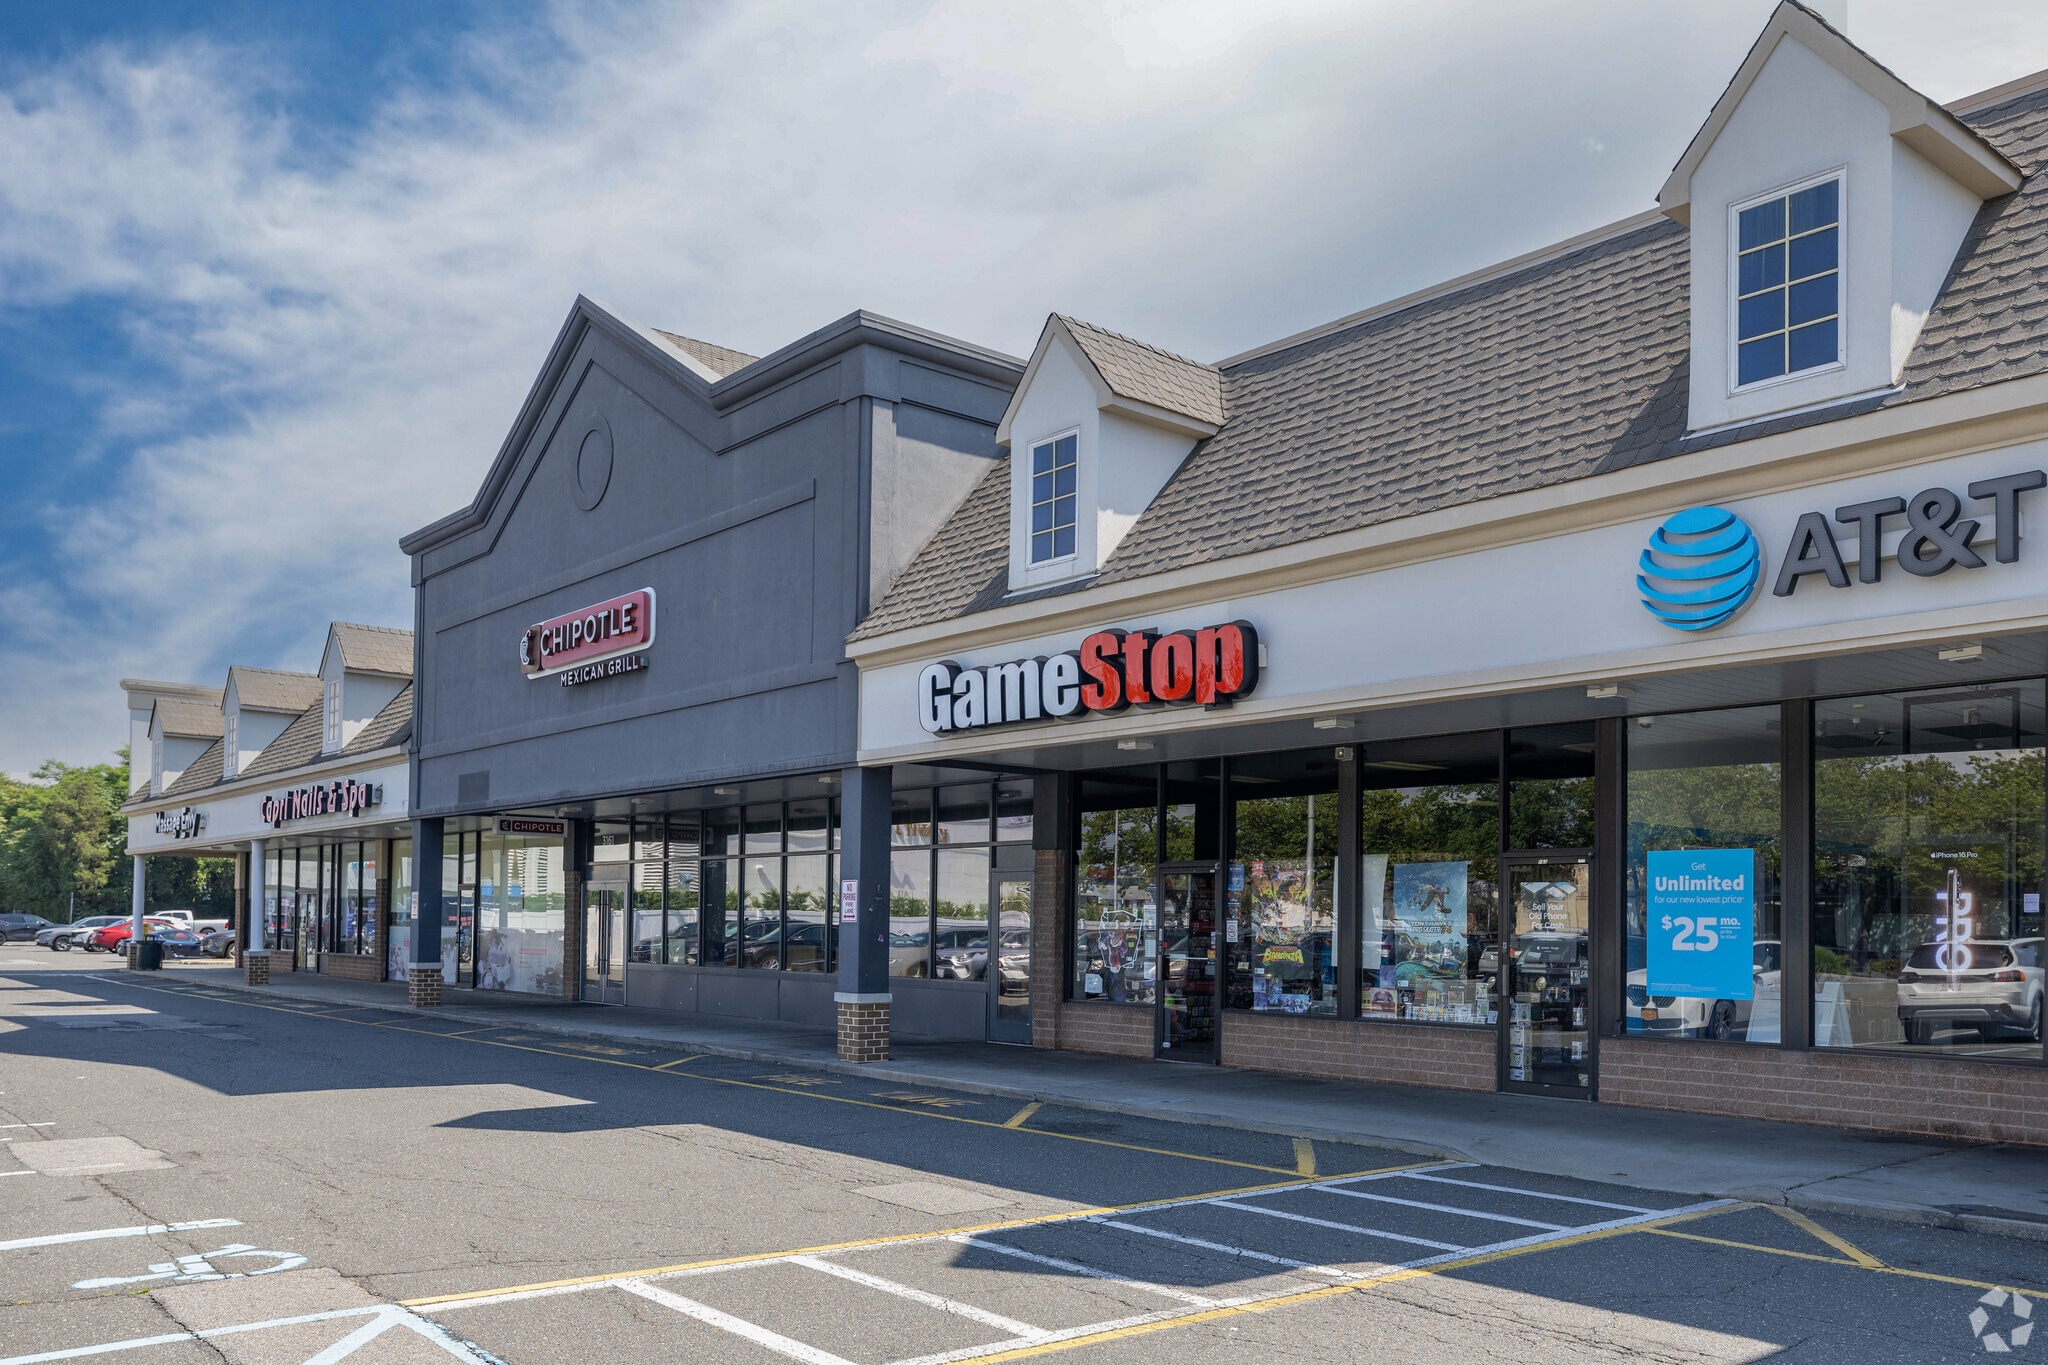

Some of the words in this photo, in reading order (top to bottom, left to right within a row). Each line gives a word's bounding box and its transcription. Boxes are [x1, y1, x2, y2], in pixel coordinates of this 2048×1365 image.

[1773, 469, 2047, 597] AT&T
[540, 602, 637, 657] CHIPOTLE
[560, 664, 604, 688] MEXICAN
[608, 655, 640, 676] GRILL
[918, 620, 1257, 736] GameStop
[260, 791, 290, 828] Capri
[292, 785, 325, 820] Nails
[327, 781, 341, 813] &
[342, 779, 372, 817] Spa
[155, 810, 181, 839] Massage
[514, 822, 563, 833] CHIPOTLE
[1691, 862, 1706, 871] Get
[847, 883, 852, 892] NO
[1655, 874, 1744, 892] Unlimited
[1532, 903, 1546, 911] Sell
[1547, 903, 1564, 911] Your
[1654, 895, 1665, 904] for
[1696, 895, 1721, 904] lowest
[1529, 912, 1542, 920] Old
[1543, 912, 1567, 920] Phone
[1531, 922, 1542, 930] For
[1544, 922, 1565, 930] Cash
[1661, 914, 1719, 952] $25
[1720, 917, 1741, 926] mo.
[1936, 893, 1972, 972] PRO
[1263, 948, 1304, 964] BANANZA
